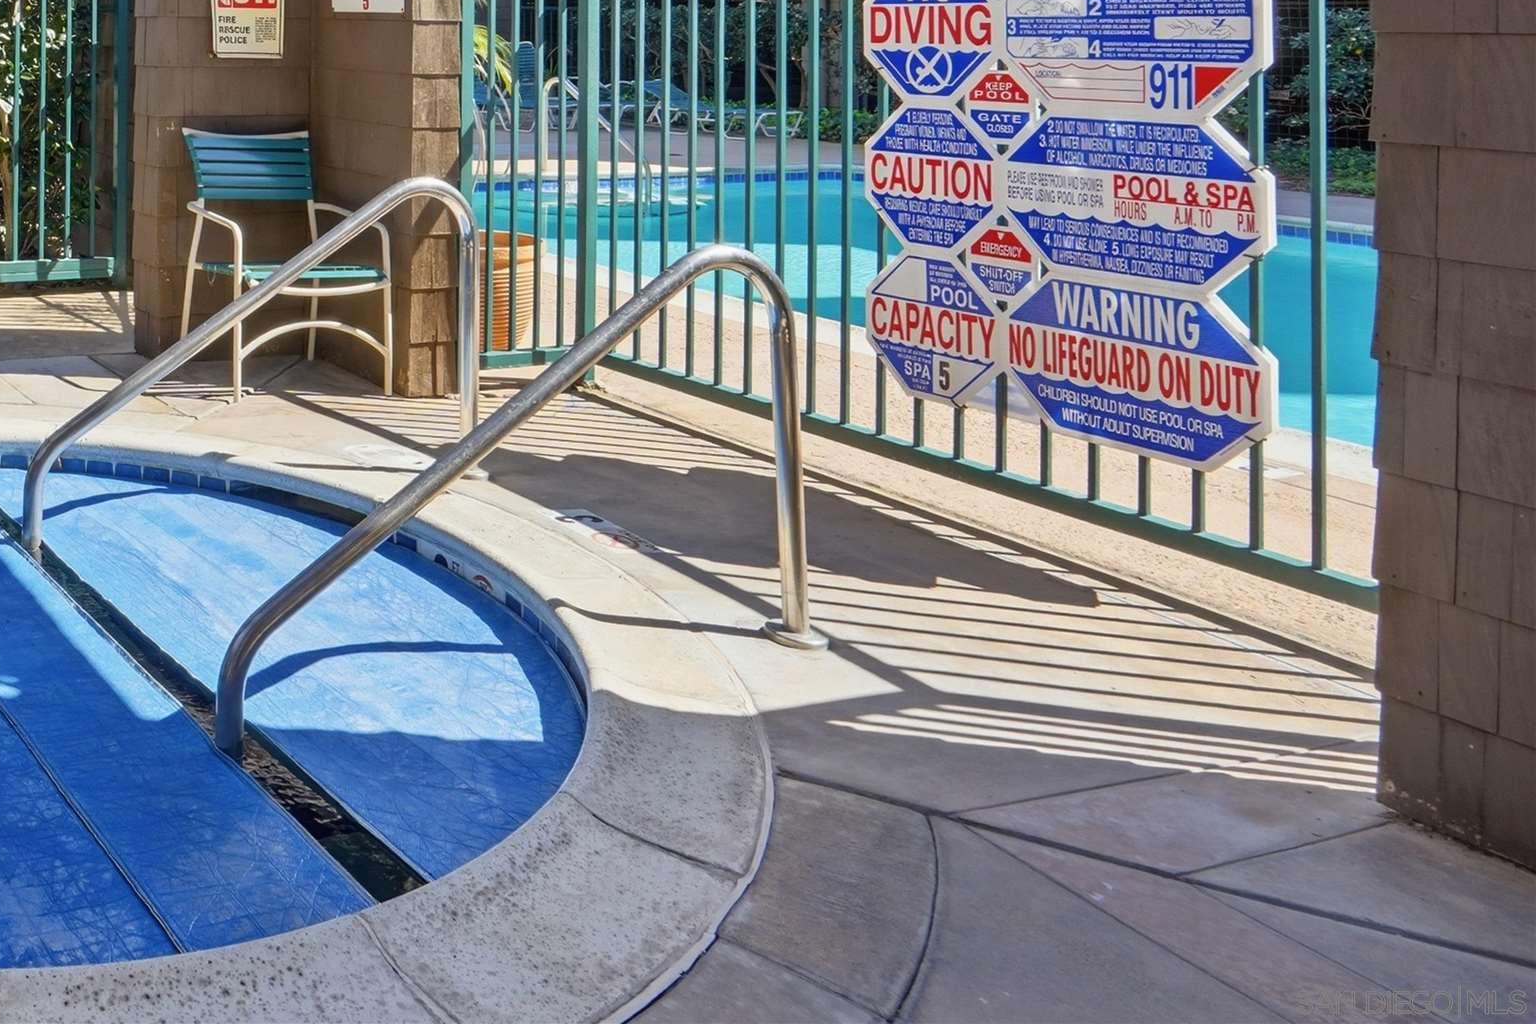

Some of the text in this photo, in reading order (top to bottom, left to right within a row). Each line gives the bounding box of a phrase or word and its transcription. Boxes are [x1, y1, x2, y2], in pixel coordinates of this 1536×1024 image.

[218, 16, 237, 24] FIRE
[219, 26, 250, 34] RESCUE
[870, 4, 992, 46] DIVING
[1007, 19, 1016, 35] 3
[219, 36, 248, 44] POLICE
[1089, 40, 1102, 58] 4
[974, 90, 1024, 101] POOL
[986, 82, 1013, 90] KEEP
[1150, 63, 1192, 109] 911
[978, 112, 1022, 124] GATE
[986, 123, 1014, 134] CLOSED
[904, 138, 918, 150] WITH
[920, 139, 940, 152] HEALTH
[942, 140, 978, 156] CONDITIONS
[1157, 142, 1172, 157] THE
[1172, 144, 1214, 160] INFLUENCE
[1046, 150, 1056, 163] OF
[1130, 156, 1154, 171] DRUGS
[1155, 158, 1166, 172] OR
[1167, 159, 1208, 176] MEDICINES
[871, 153, 992, 202] CAUTION
[1008, 185, 1034, 201] BEFORE
[1057, 190, 1076, 206] POOL
[1078, 193, 1088, 207] OR
[1090, 194, 1104, 208] SPA
[1113, 174, 1256, 212] POOL & SPA
[1114, 200, 1260, 234] HOURS A.M. TO P.M.
[1040, 217, 1056, 232] LEAD
[1056, 219, 1064, 233] TO
[1140, 230, 1154, 244] AND
[1154, 231, 1161, 245] IS
[1162, 232, 1175, 247] NOT
[1176, 234, 1229, 254] RECOMMENDED
[980, 242, 1023, 258] EMERGENCY
[1062, 235, 1074, 249] NOT
[1076, 236, 1088, 251] USE
[1122, 242, 1139, 258] LONG
[1140, 245, 1174, 263] EXPOSURE
[1174, 250, 1188, 265] MAY
[1189, 252, 1215, 268] RESULT
[980, 266, 1024, 282] SHUT-OFF
[1130, 260, 1163, 278] DIZZINESS
[1164, 264, 1174, 279] OR
[1174, 266, 1205, 283] FAINTING
[930, 285, 979, 310] POOL
[988, 280, 1016, 294] SWITCH
[872, 296, 996, 358] CAPACITY
[1052, 282, 1200, 350] WARNING
[904, 360, 932, 380] SPA
[938, 361, 950, 391] 5
[1009, 324, 1261, 418] NO LIFEGUARD ON DUTY
[1038, 384, 1225, 440] CHILDREN SHOULD NOT USE POOL OR SPA
[1062, 407, 1195, 452] WITHOUT ADULT SUPERVISION
